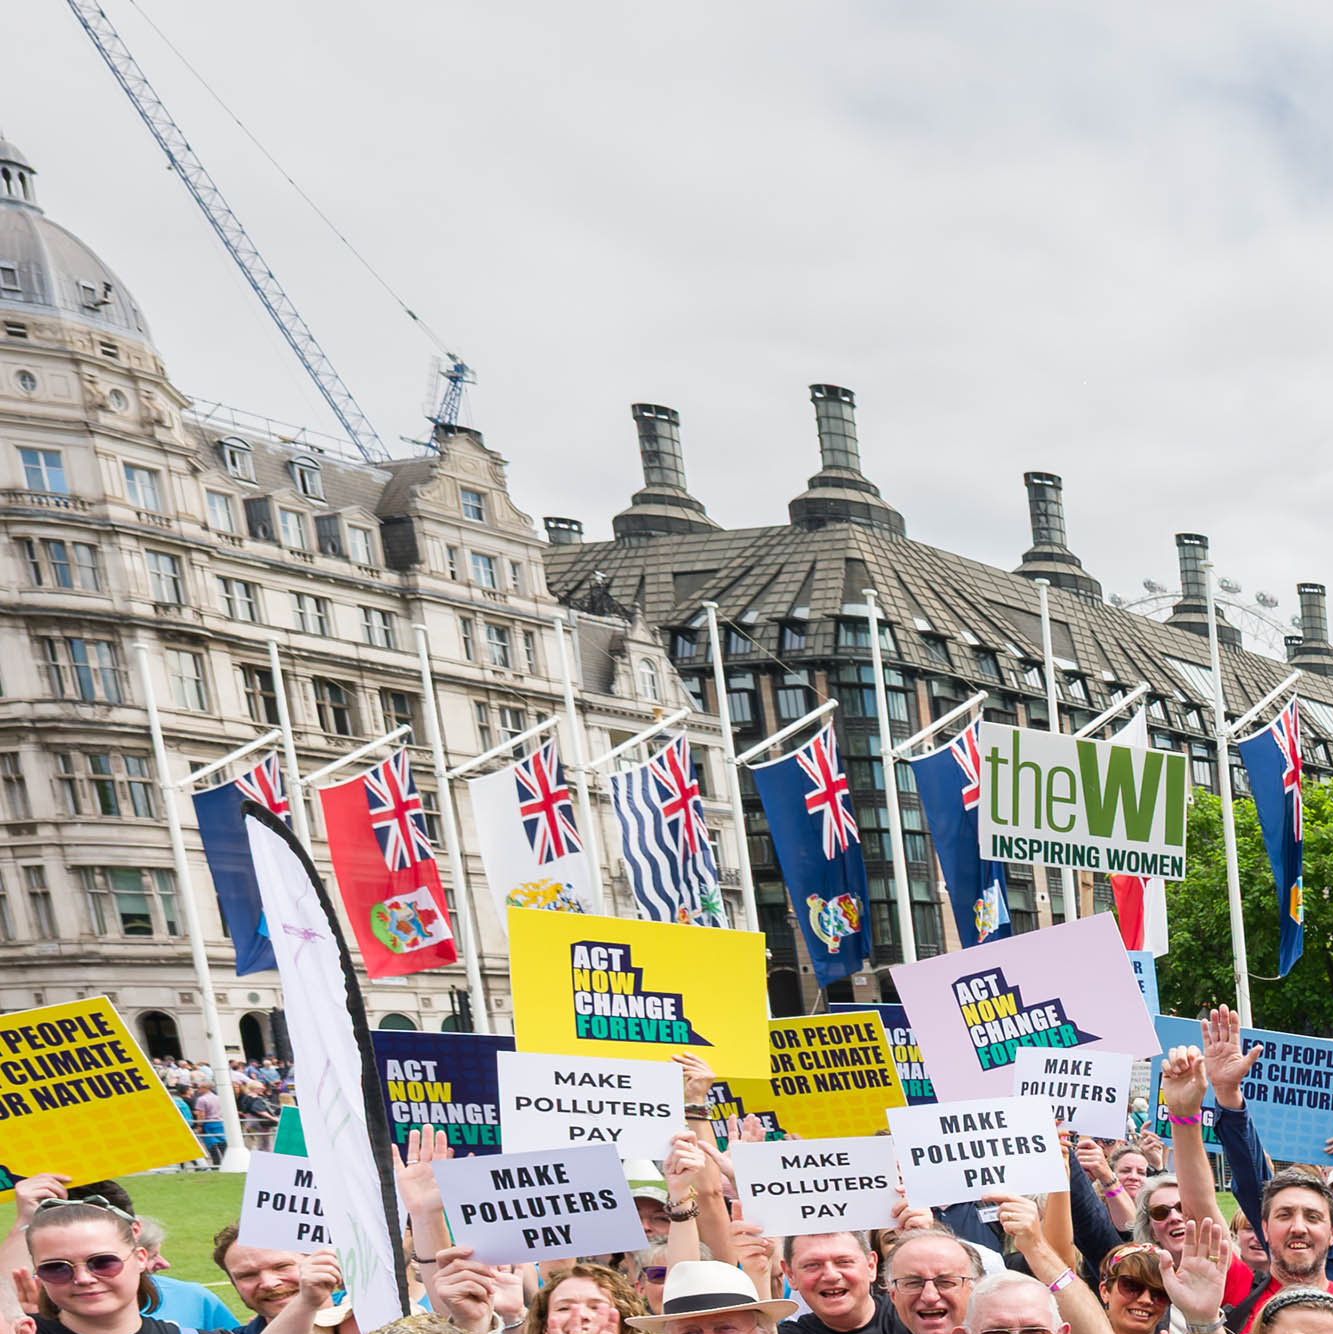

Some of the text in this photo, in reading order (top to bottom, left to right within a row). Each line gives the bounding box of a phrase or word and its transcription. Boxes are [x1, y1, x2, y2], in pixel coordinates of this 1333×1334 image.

[992, 834, 1183, 877] INSPIRING WOMEN
[573, 944, 623, 971] ACT
[574, 968, 634, 995] NOW
[575, 992, 676, 1021] CHANGE
[1, 1012, 115, 1053] PEOPLE
[577, 1015, 688, 1043] FOREVER
[805, 1023, 878, 1046] PEOPLE
[1, 1040, 133, 1085] CLIMATE
[798, 1046, 885, 1070] CLIMATE
[29, 1068, 150, 1110] NATURE
[554, 1071, 632, 1089] MAKE
[771, 1068, 892, 1096] FOR NATURE
[515, 1097, 671, 1118] POLLUTERS
[569, 1126, 622, 1142] PAY
[939, 1110, 1007, 1135] MAKE
[781, 1152, 850, 1170] MAKE
[911, 1135, 1046, 1166] POLLUTERS
[491, 1163, 569, 1190] MAKE
[752, 1175, 888, 1197] POLLUTERS
[964, 1166, 1006, 1188] PAY
[461, 1189, 618, 1224] POLLUTERS
[802, 1203, 848, 1219] PAY
[522, 1224, 572, 1249] PAY
